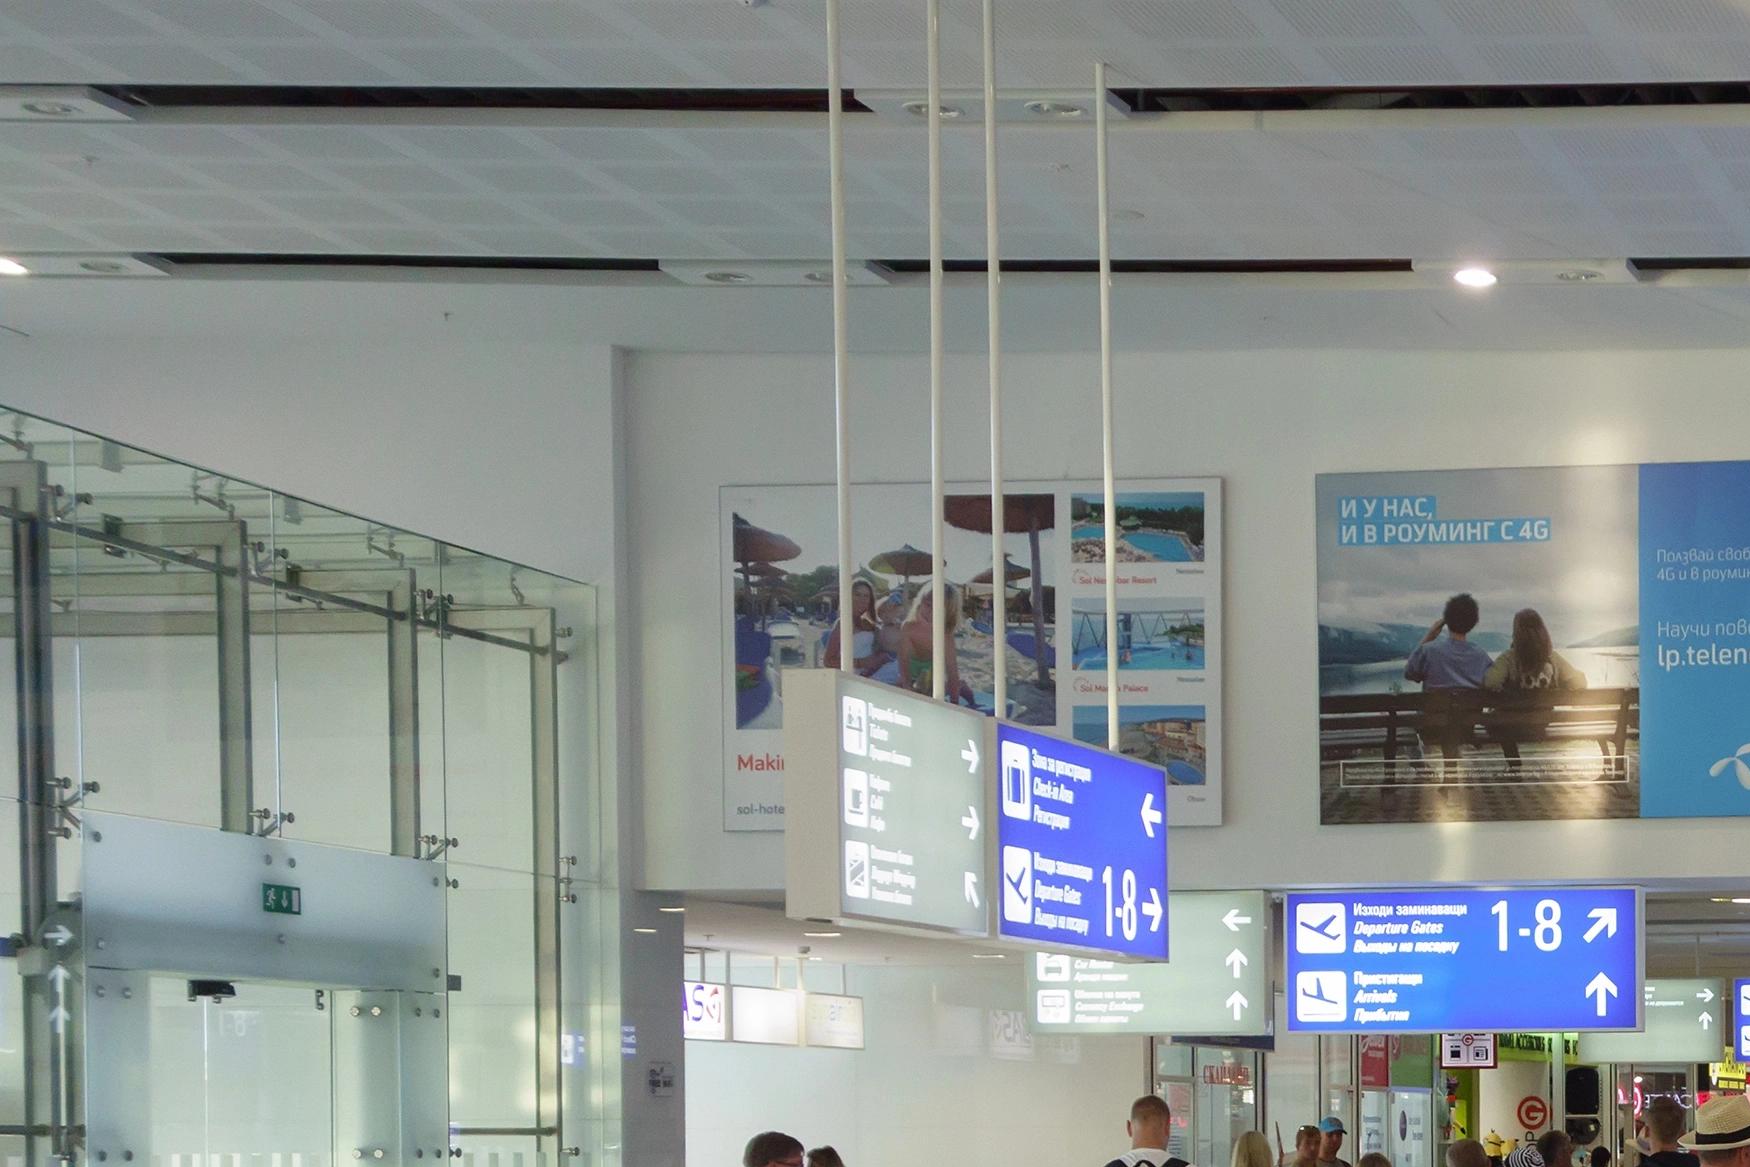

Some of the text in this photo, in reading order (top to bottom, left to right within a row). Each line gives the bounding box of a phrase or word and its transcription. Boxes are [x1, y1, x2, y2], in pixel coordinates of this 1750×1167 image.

[1341, 497, 1433, 521] И У НАС,
[1341, 520, 1549, 544] И В РОУМИНГ С 4G
[1657, 548, 1714, 565] Ползвай
[1657, 567, 1675, 582] 4G
[1679, 568, 1688, 581] и
[1690, 566, 1699, 581] в
[1658, 620, 1709, 639] Научи
[1102, 865, 1137, 942] 1-8
[1354, 920, 1443, 937] Departure Gates
[1491, 899, 1562, 952] 1-8
[1354, 990, 1397, 1003] Arrivals
